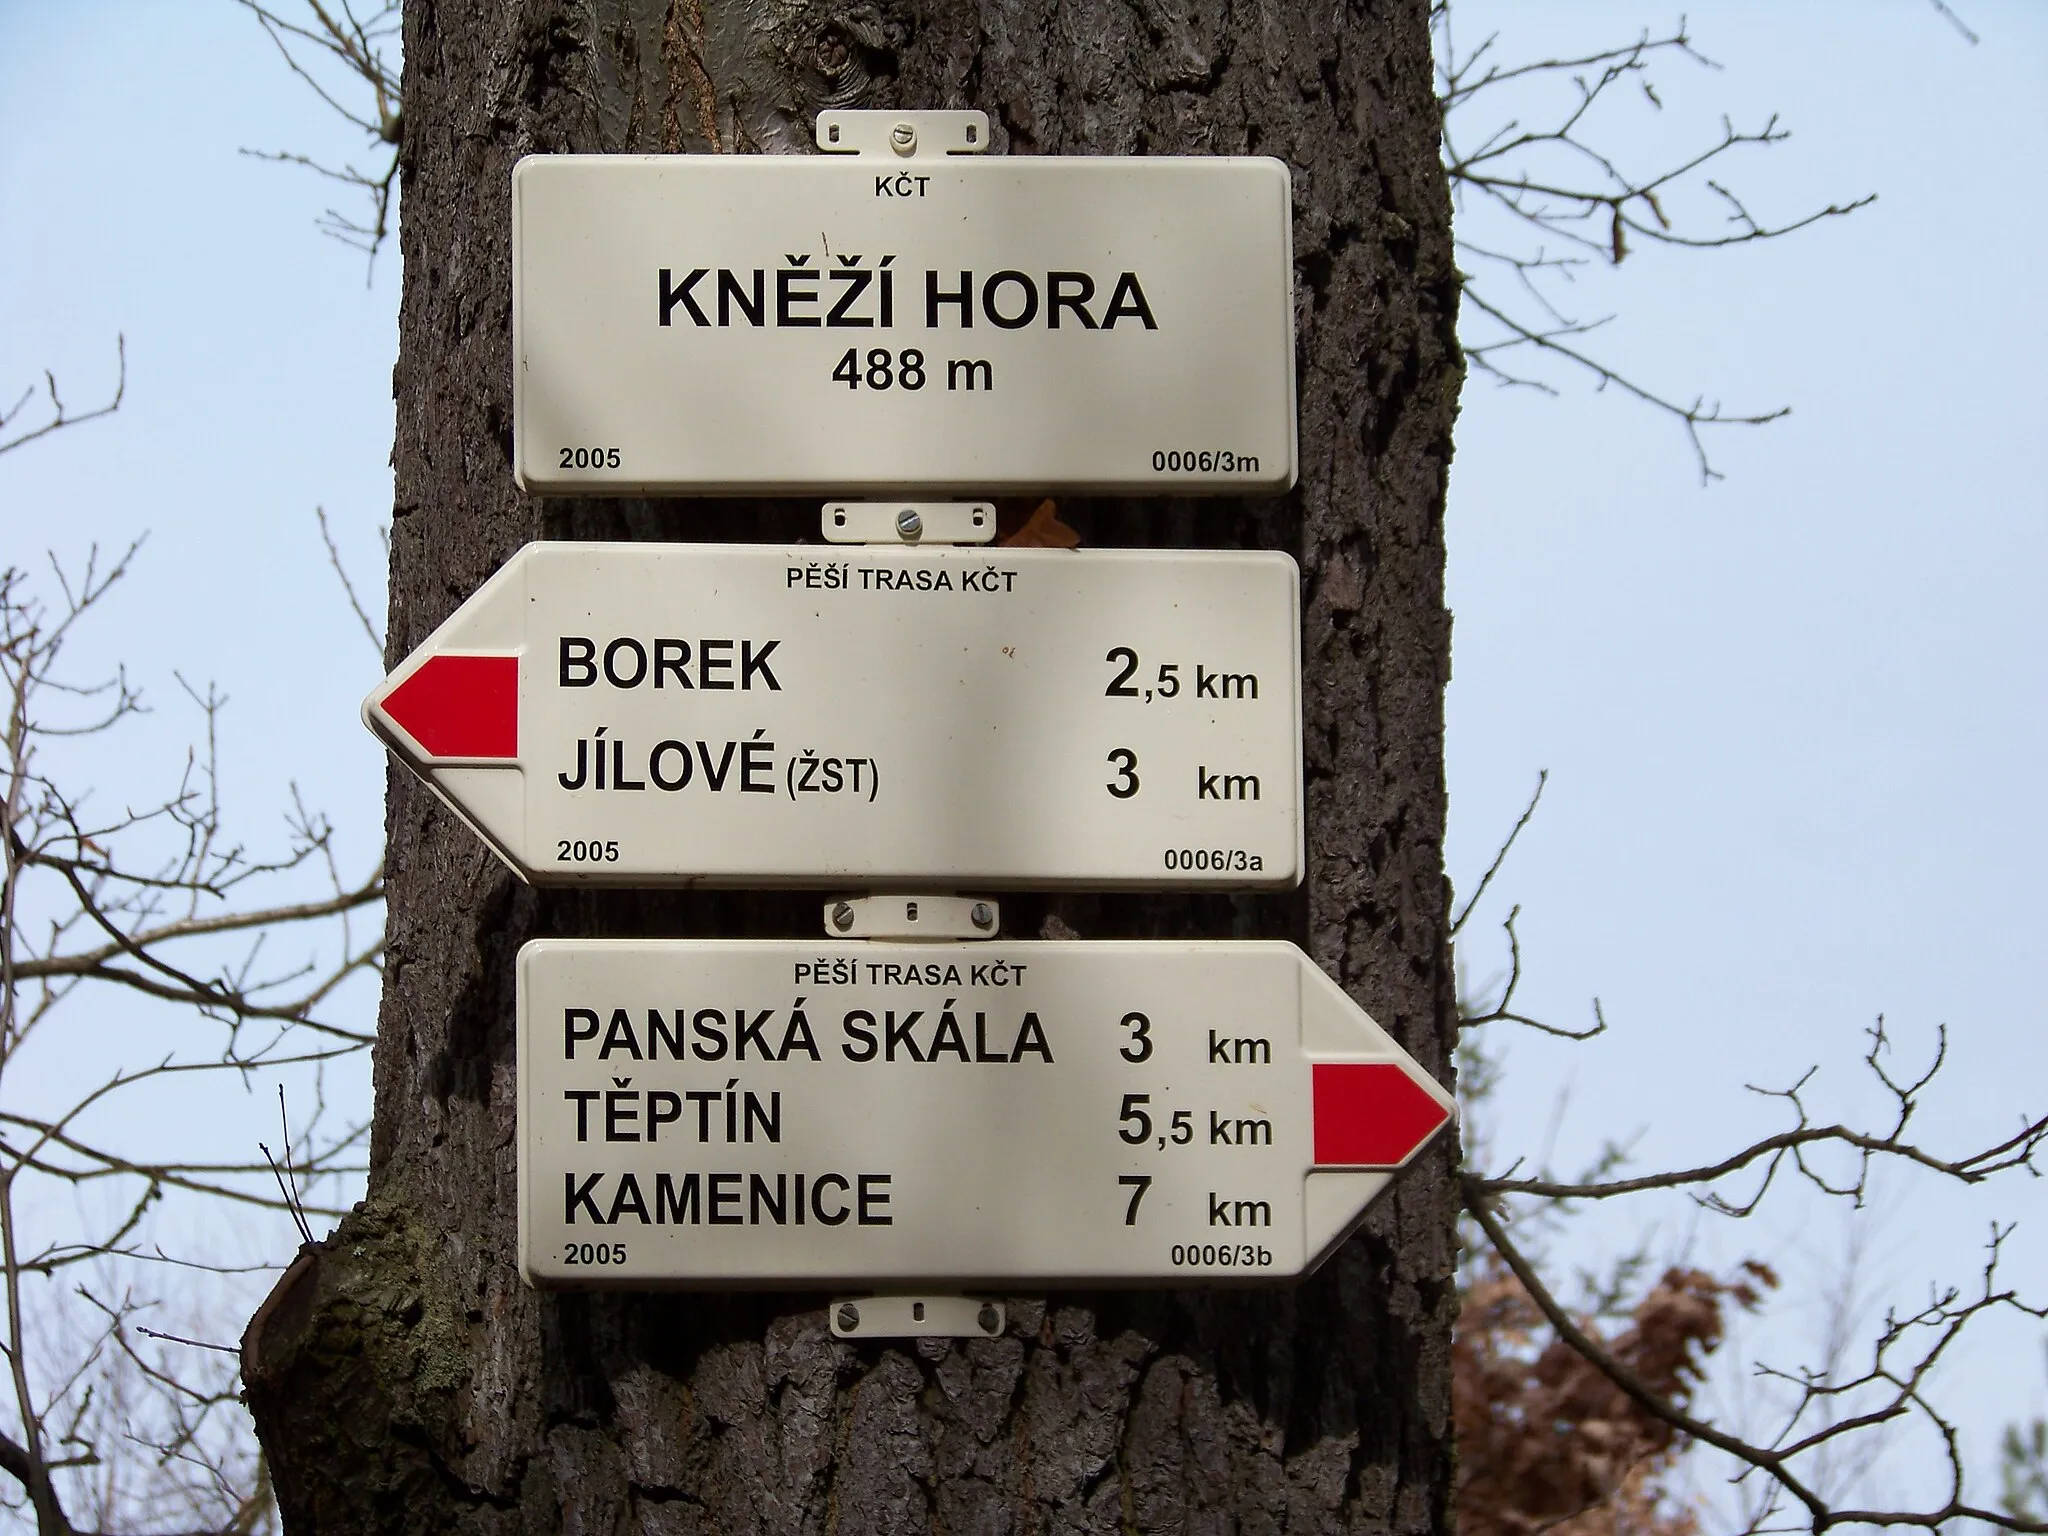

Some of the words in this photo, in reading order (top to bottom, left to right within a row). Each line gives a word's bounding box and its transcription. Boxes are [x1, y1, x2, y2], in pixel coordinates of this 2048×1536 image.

[875, 171, 931, 198] KČT
[658, 254, 896, 329] KNĚŽÍ
[925, 270, 1159, 331] HORA
[832, 347, 926, 391] 488
[947, 359, 993, 391] m
[559, 447, 621, 469] 2005
[1152, 450, 1260, 474] 0006/3m
[787, 561, 850, 590] PĚŠÍ
[857, 568, 954, 592] TRASA
[962, 565, 1018, 593] KČT
[559, 636, 782, 691] BOREK
[1104, 646, 1181, 704] 2,5
[1196, 664, 1258, 699] km
[1106, 747, 1140, 799] 3
[1198, 765, 1260, 801] km
[557, 840, 619, 862] 2005
[1164, 849, 1263, 872] 0006/3a
[794, 957, 858, 985] PĚŠÍ
[865, 963, 962, 987] TRASA
[970, 959, 1028, 987] KČT
[564, 996, 822, 1062] PANSKÁ
[841, 998, 1055, 1064] SKÁLA
[1119, 1011, 1153, 1064] 3
[1208, 1029, 1271, 1064] km
[563, 1076, 781, 1144] TĚPTÍN
[1118, 1093, 1194, 1152] 5,5
[1209, 1110, 1272, 1146] km
[564, 1172, 893, 1227] KAMENICE
[1118, 1175, 1153, 1227] 7
[1209, 1191, 1272, 1227] km
[563, 1242, 627, 1266] 2005
[1171, 1244, 1273, 1267] 0006/3b
